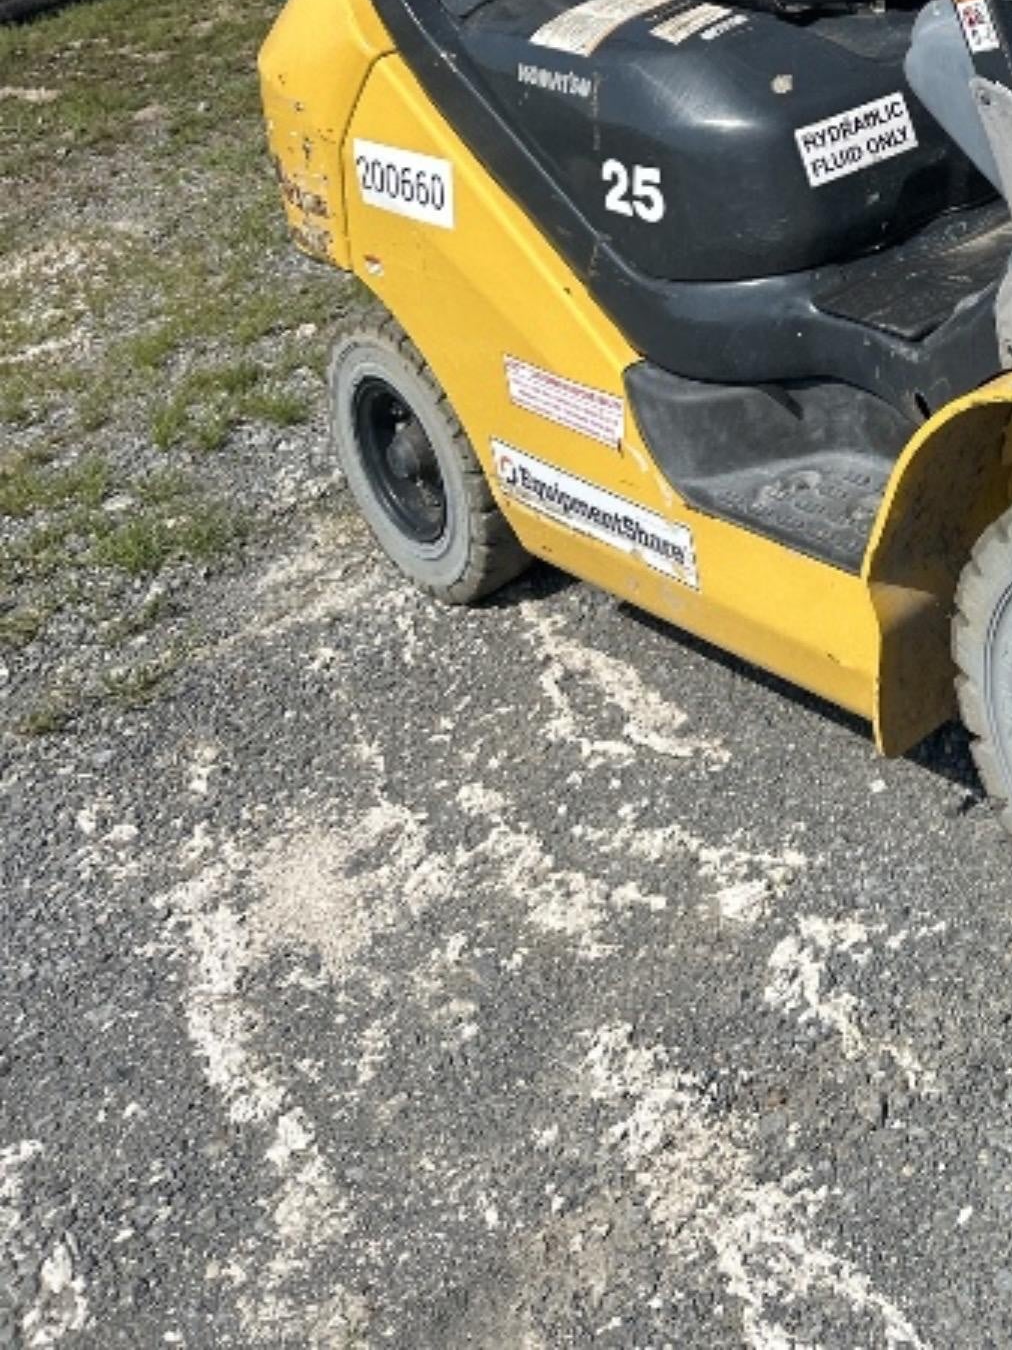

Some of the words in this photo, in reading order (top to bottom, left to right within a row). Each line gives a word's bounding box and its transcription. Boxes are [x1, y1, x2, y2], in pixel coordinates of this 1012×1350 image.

[802, 101, 904, 153] HYDRAULIC
[810, 145, 864, 177] FLUID
[866, 125, 908, 154] ONLY
[355, 155, 445, 211] 200660
[602, 158, 666, 223] 25
[517, 463, 686, 566] EquipmentShare
